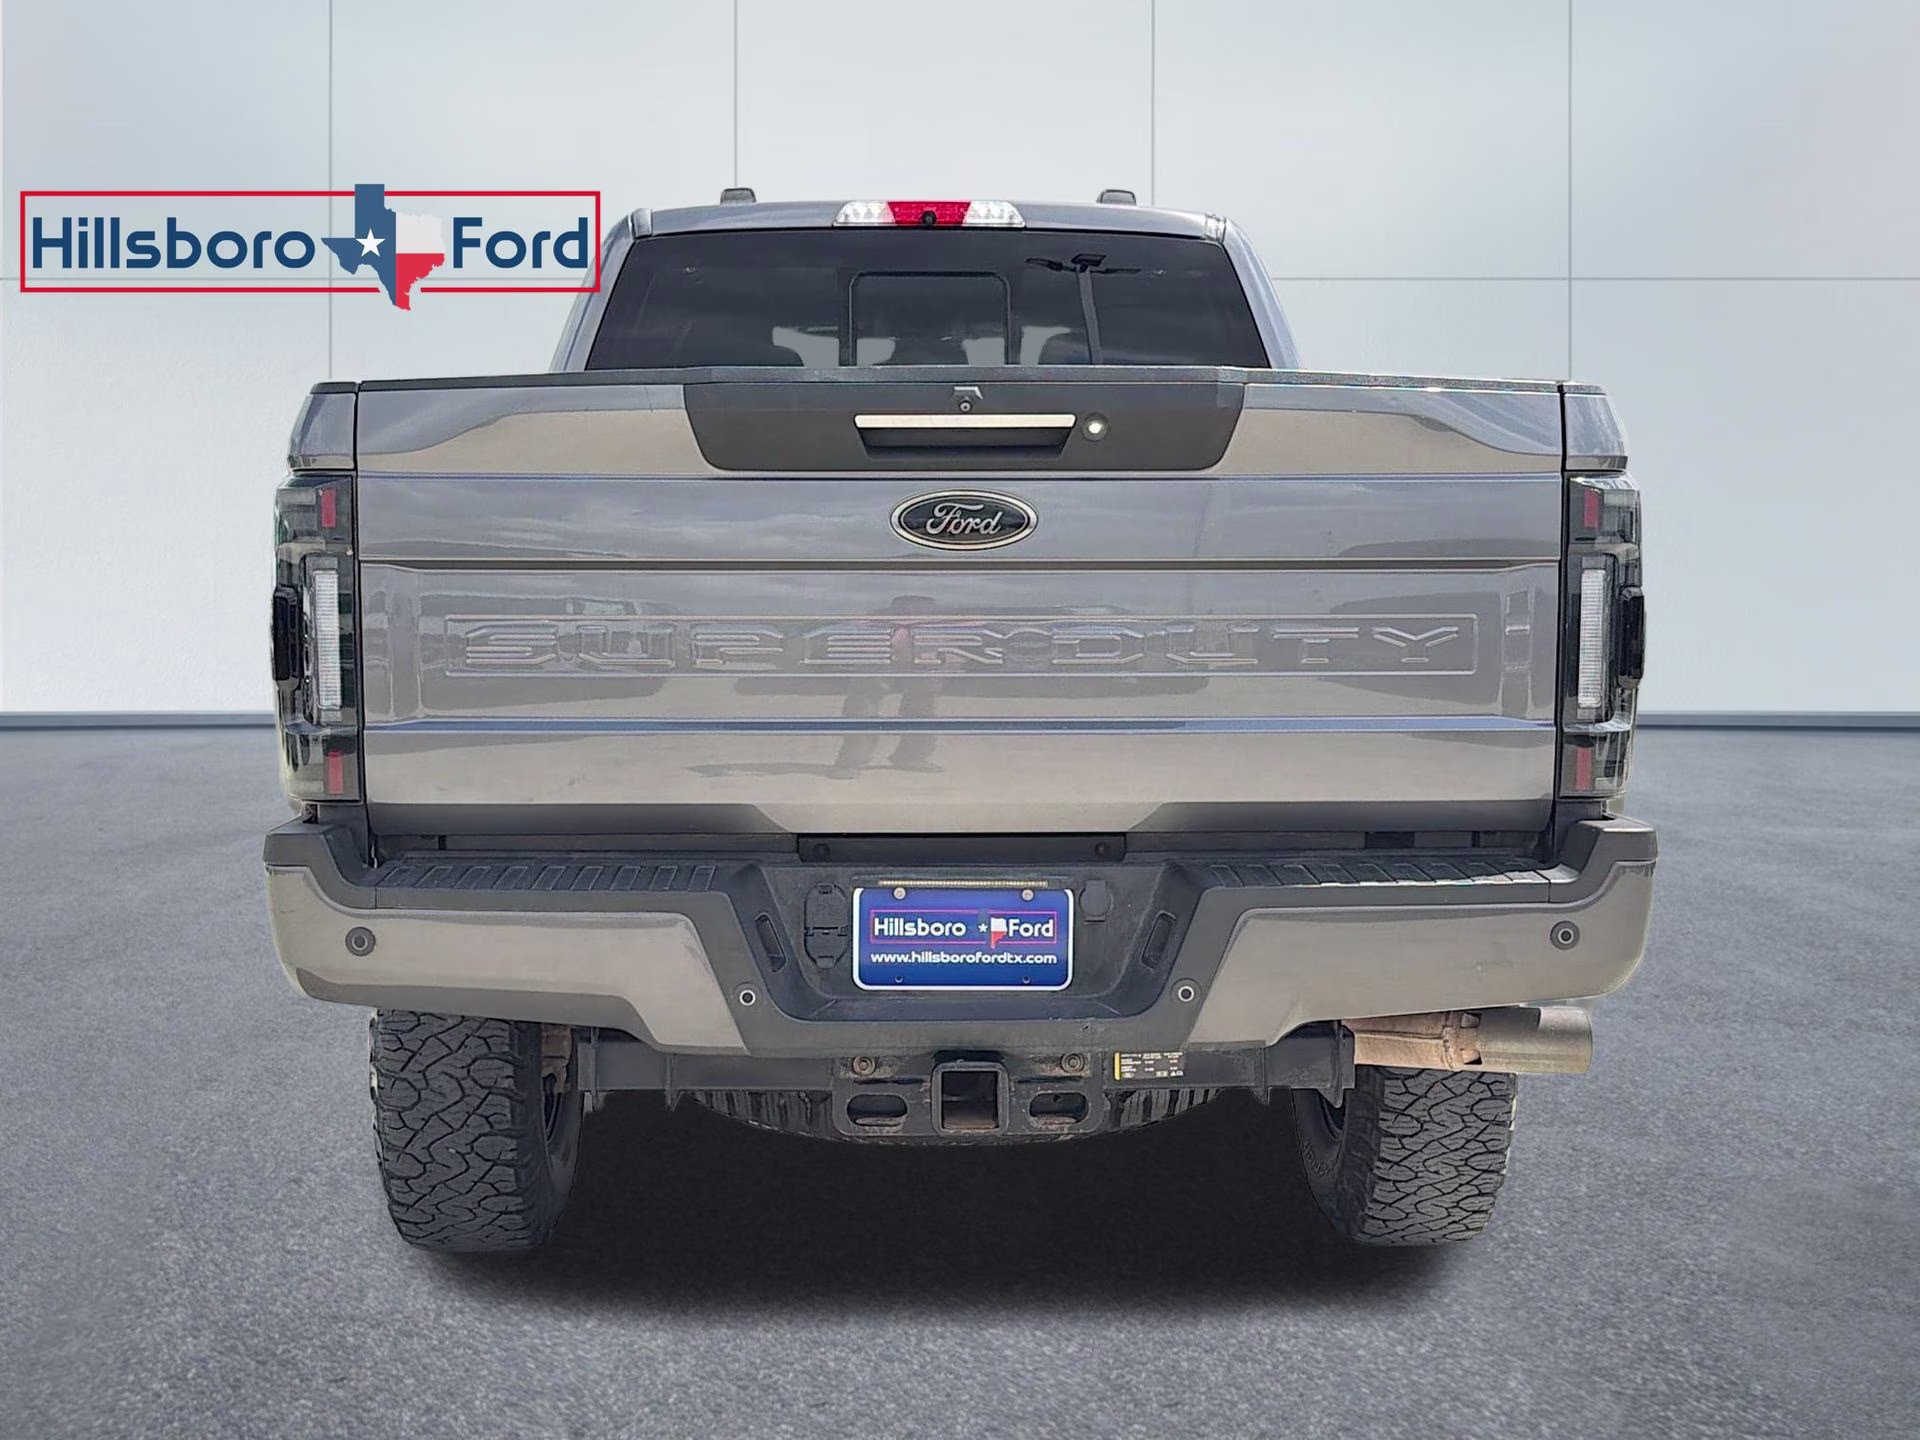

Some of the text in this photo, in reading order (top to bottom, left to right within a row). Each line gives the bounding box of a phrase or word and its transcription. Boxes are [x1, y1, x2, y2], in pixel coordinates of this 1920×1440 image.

[925, 502, 1004, 535] Ford
[464, 622, 1460, 667] SUPER DUTY
[873, 917, 1054, 938] Hillsboro Ford
[870, 950, 1058, 965] www.hillsborofordtx.com
